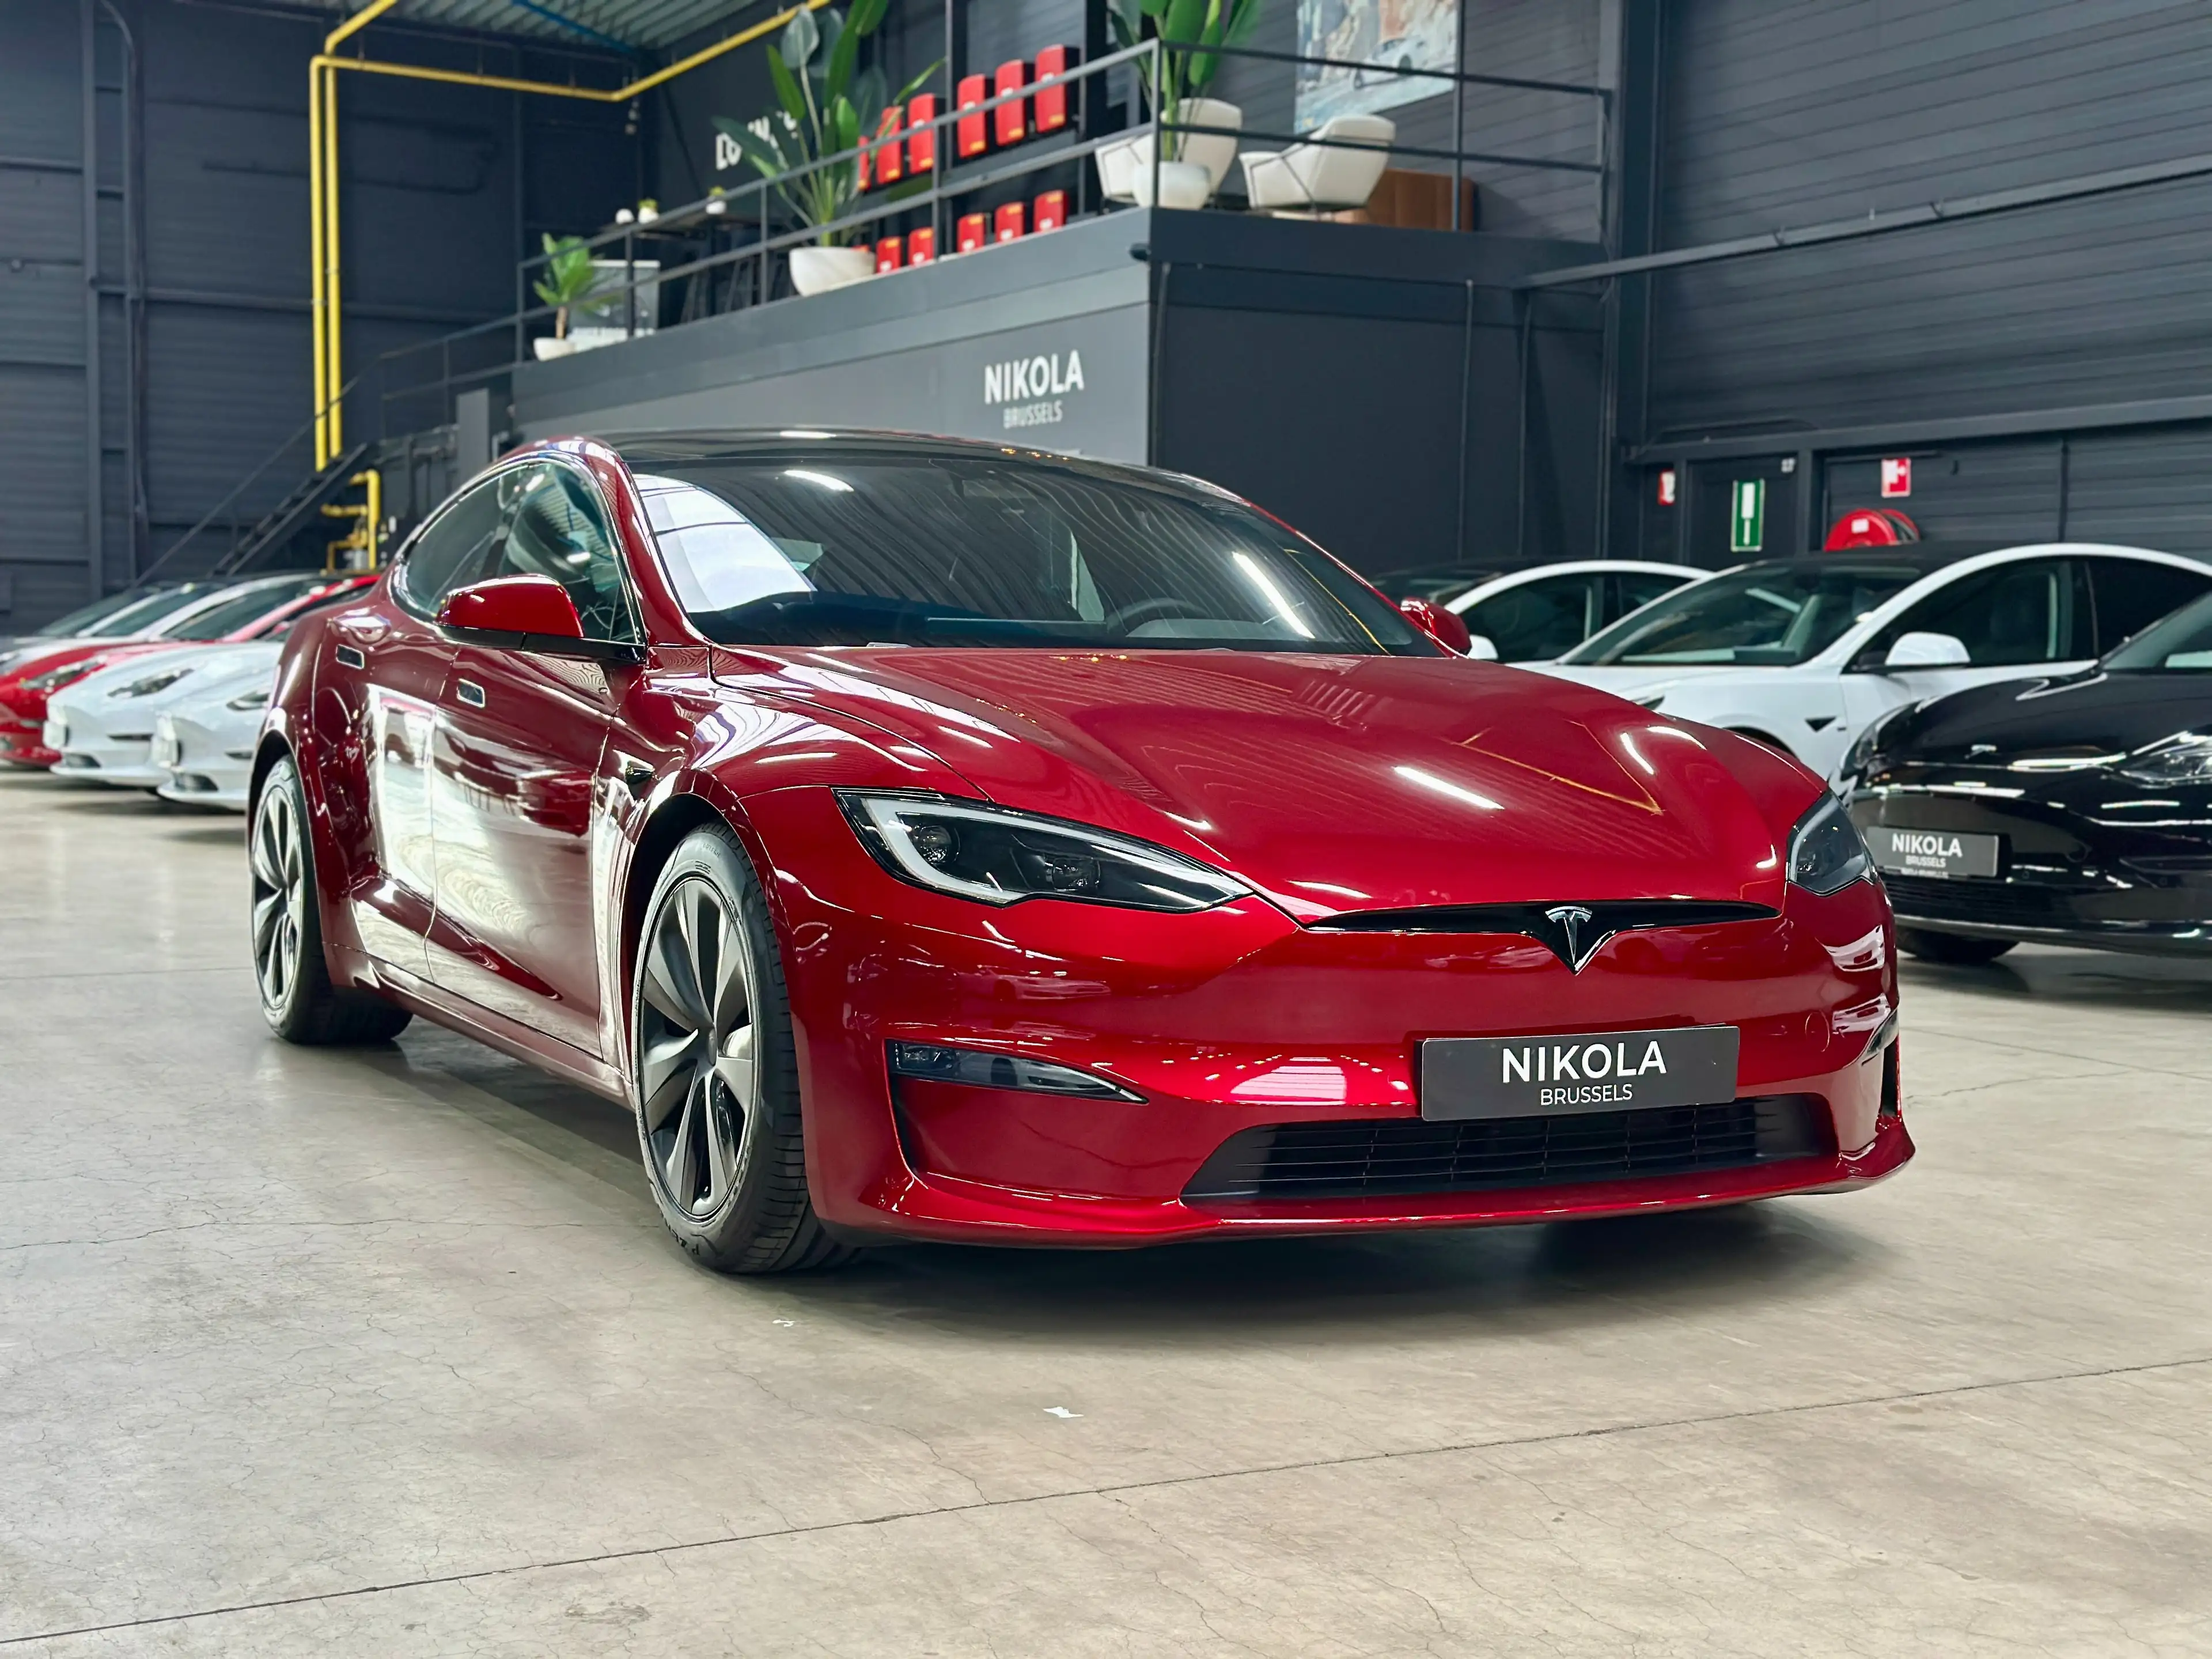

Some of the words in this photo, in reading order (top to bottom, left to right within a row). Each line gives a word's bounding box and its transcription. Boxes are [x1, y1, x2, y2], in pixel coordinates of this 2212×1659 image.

[984, 349, 1085, 404] NIKOLA
[1003, 400, 1063, 429] BRUSSELS
[1892, 833, 1963, 857] NIKOLA
[1905, 855, 1946, 868] BRUSSELS
[1502, 1040, 1667, 1083] NIKOLA
[1540, 1084, 1633, 1105] BRUSSELS
